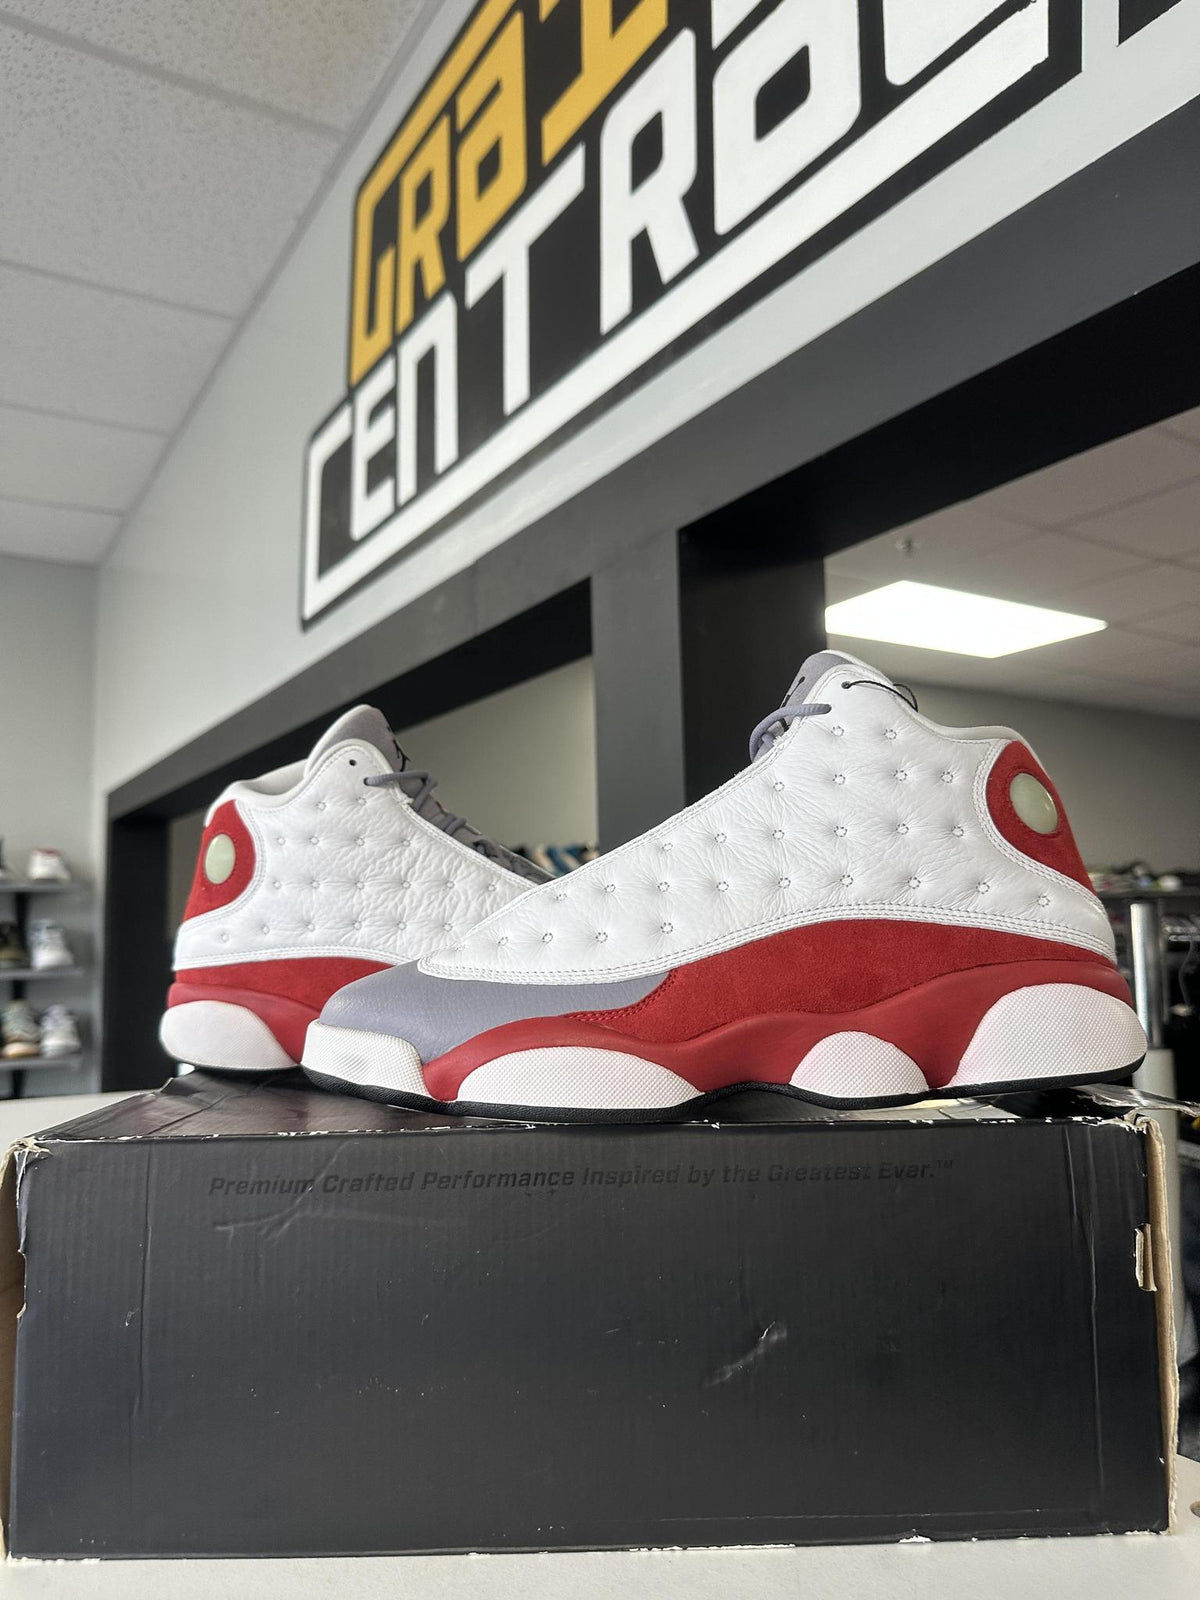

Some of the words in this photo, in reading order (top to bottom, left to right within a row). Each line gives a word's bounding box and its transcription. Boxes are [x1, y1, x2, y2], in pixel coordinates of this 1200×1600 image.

[208, 1176, 314, 1196] Premium
[322, 1171, 413, 1194] Crafted
[420, 1168, 575, 1191] Performance
[581, 1164, 679, 1188] Inspired
[687, 1164, 713, 1187] by
[722, 1163, 760, 1183] the
[767, 1162, 872, 1183] Greatest
